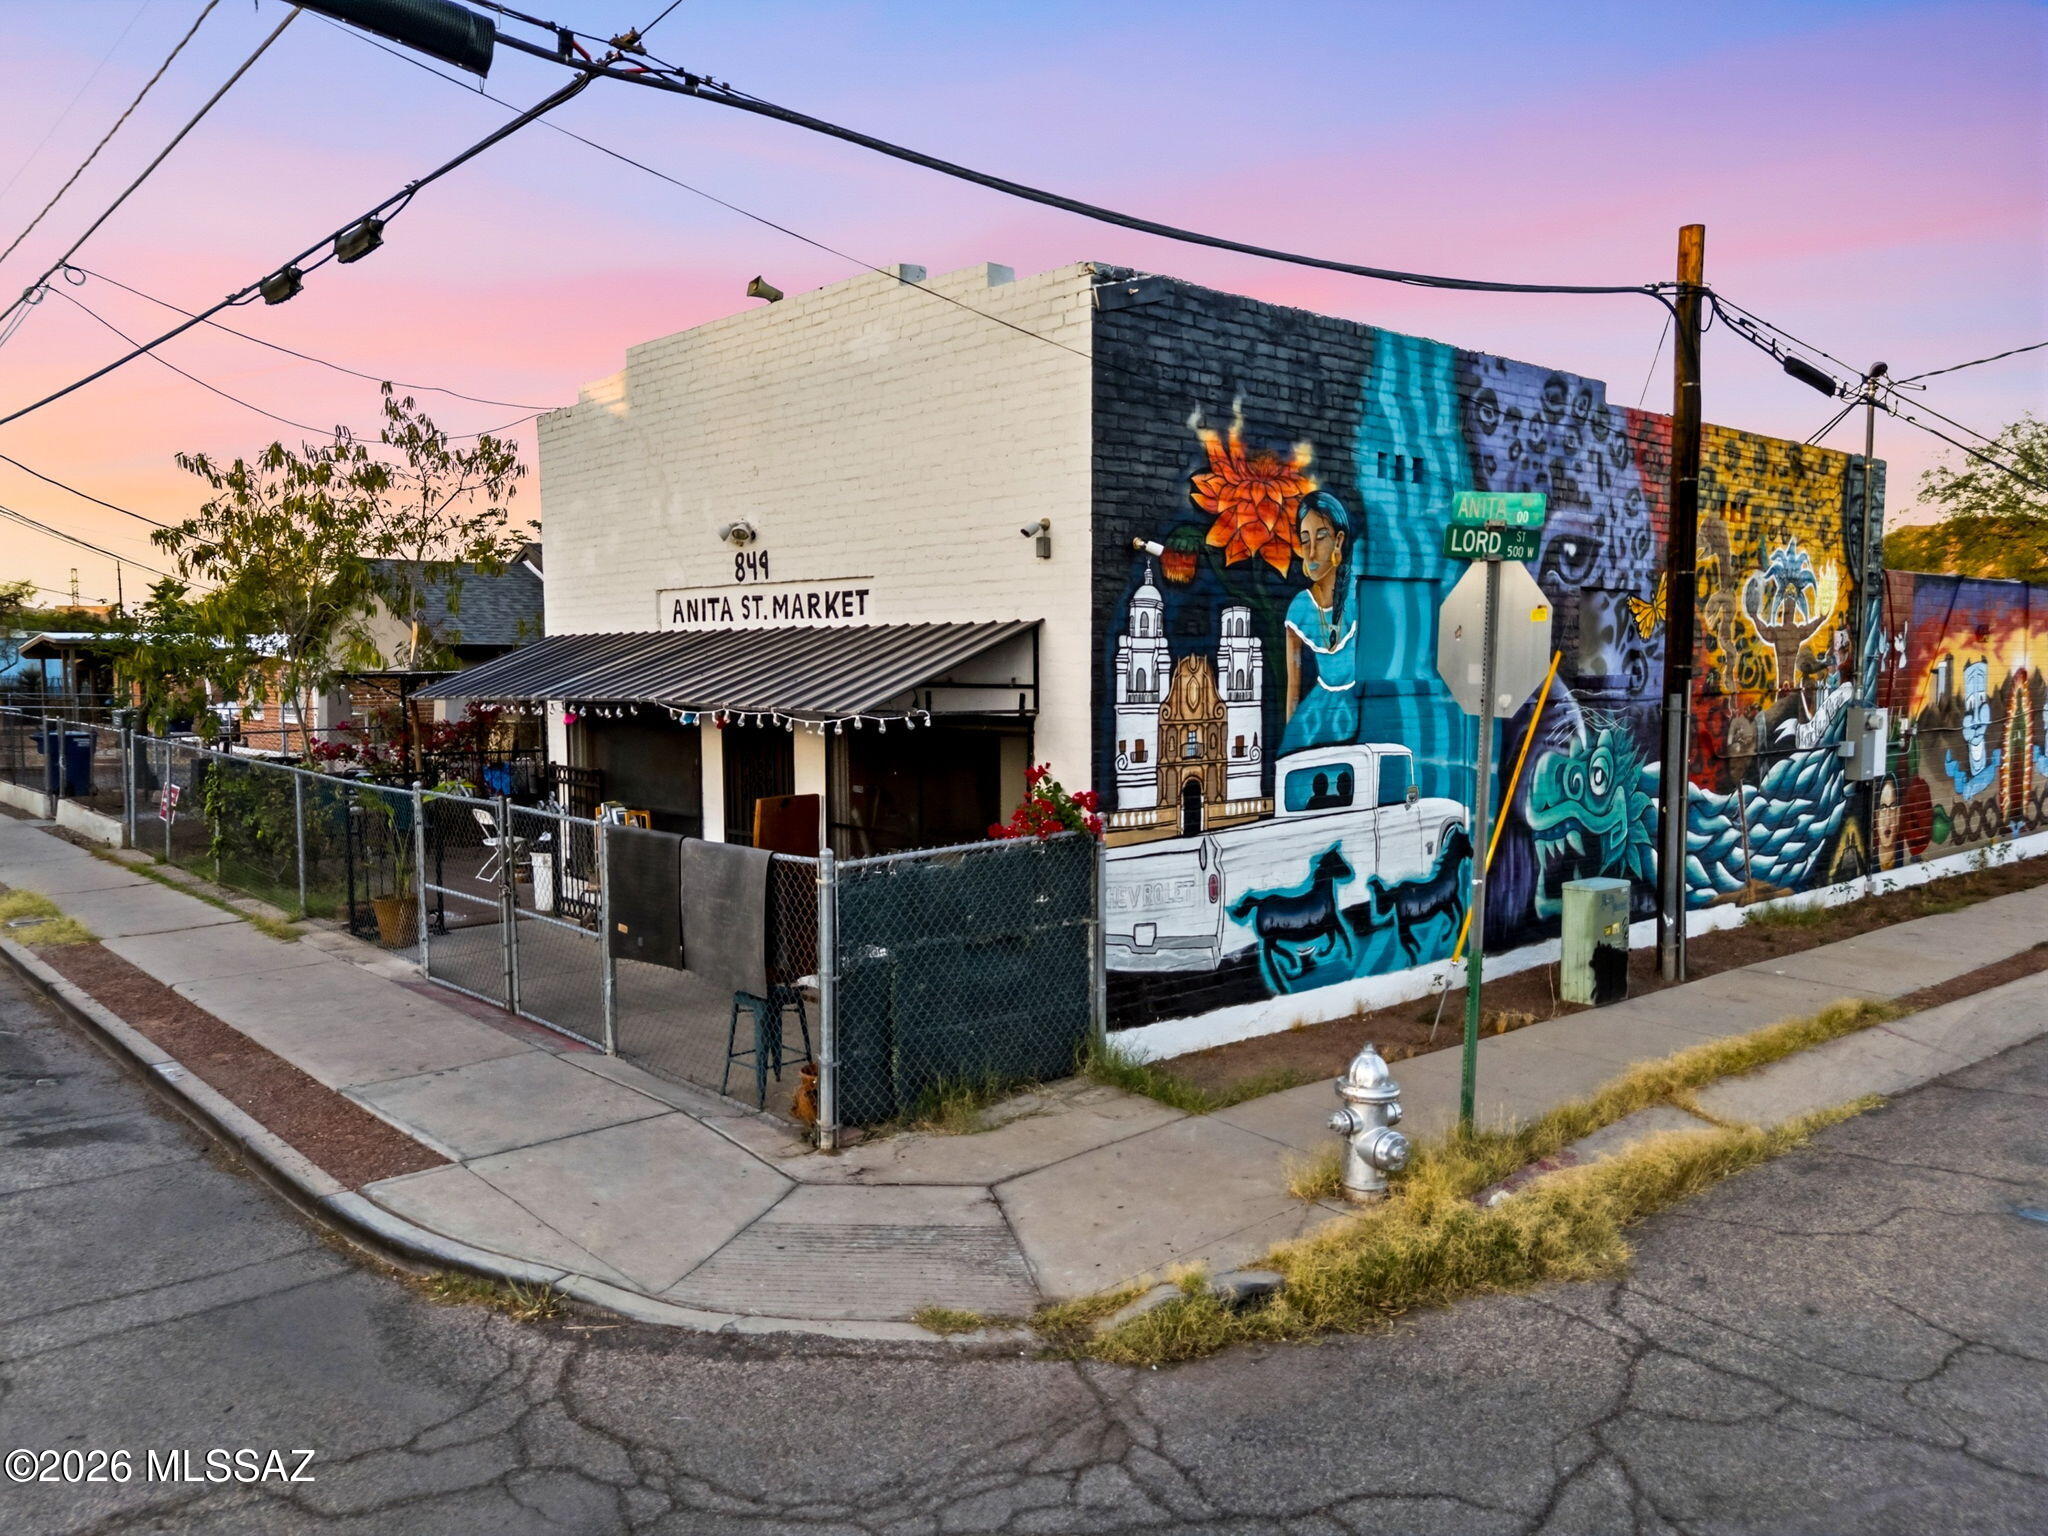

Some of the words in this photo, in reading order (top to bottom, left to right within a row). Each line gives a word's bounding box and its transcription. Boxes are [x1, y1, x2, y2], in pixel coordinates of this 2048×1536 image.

[1457, 496, 1507, 520] ANITA
[1516, 510, 1529, 523] 00
[1450, 528, 1502, 554] LORD
[1516, 531, 1526, 543] ST
[1506, 545, 1524, 558] 500
[1527, 546, 1535, 558] W
[734, 550, 769, 582] 849
[672, 596, 734, 624] ANITA
[741, 594, 768, 621] ST.
[772, 588, 870, 620] MARKET
[1105, 880, 1195, 909] HEVROLET
